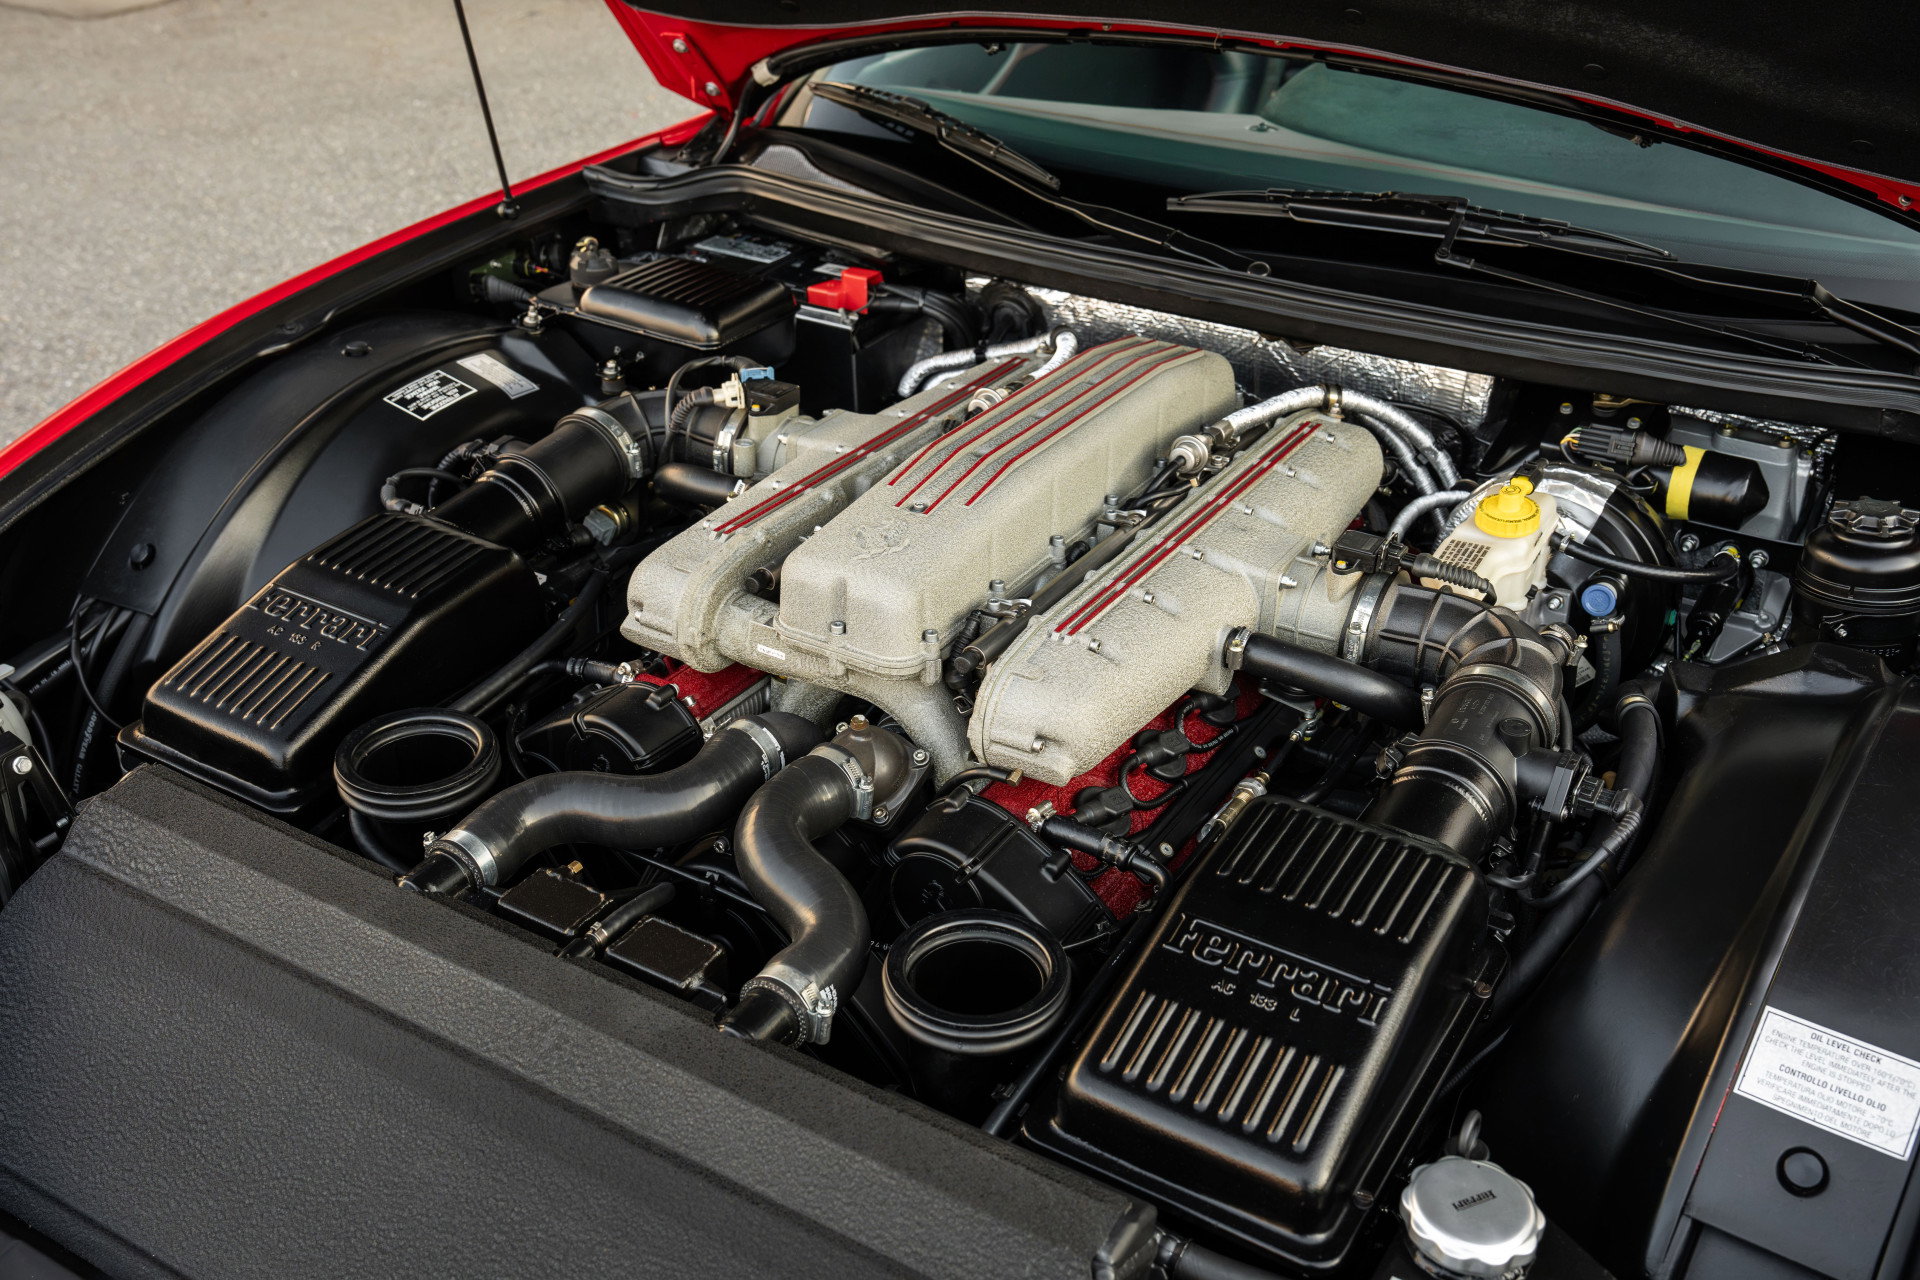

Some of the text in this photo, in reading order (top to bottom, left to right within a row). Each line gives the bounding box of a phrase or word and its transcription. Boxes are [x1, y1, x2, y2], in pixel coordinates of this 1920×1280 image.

[246, 583, 391, 652] Ferrari
[1162, 912, 1393, 1026] Ferrari
[1211, 978, 1237, 996] AC
[1289, 1007, 1301, 1022] L
[1763, 1035, 1917, 1098] CHECK THE LEVEL IMMEDIATELY AFTER THE
[1771, 1029, 1797, 1044] ENGINE
[1798, 1039, 1849, 1063] TEMPERATURE
[1850, 1058, 1871, 1071] OVER
[1809, 1032, 1882, 1064] OIL LEVEL CHECK
[1764, 1070, 1816, 1096] TEMPERATURA
[1816, 1090, 1834, 1103] OLIO
[1835, 1098, 1867, 1116] MOTORE
[1778, 1064, 1887, 1112] CONTROLLO LIVELLO OLIO
[1800, 1059, 1872, 1091] ENGINE IS STOPPED
[1755, 1077, 1796, 1098] VERIFICARE
[1862, 1118, 1884, 1133] DOPO
[1823, 1114, 1839, 1125] DEL
[1839, 1120, 1871, 1138] MOTORE
